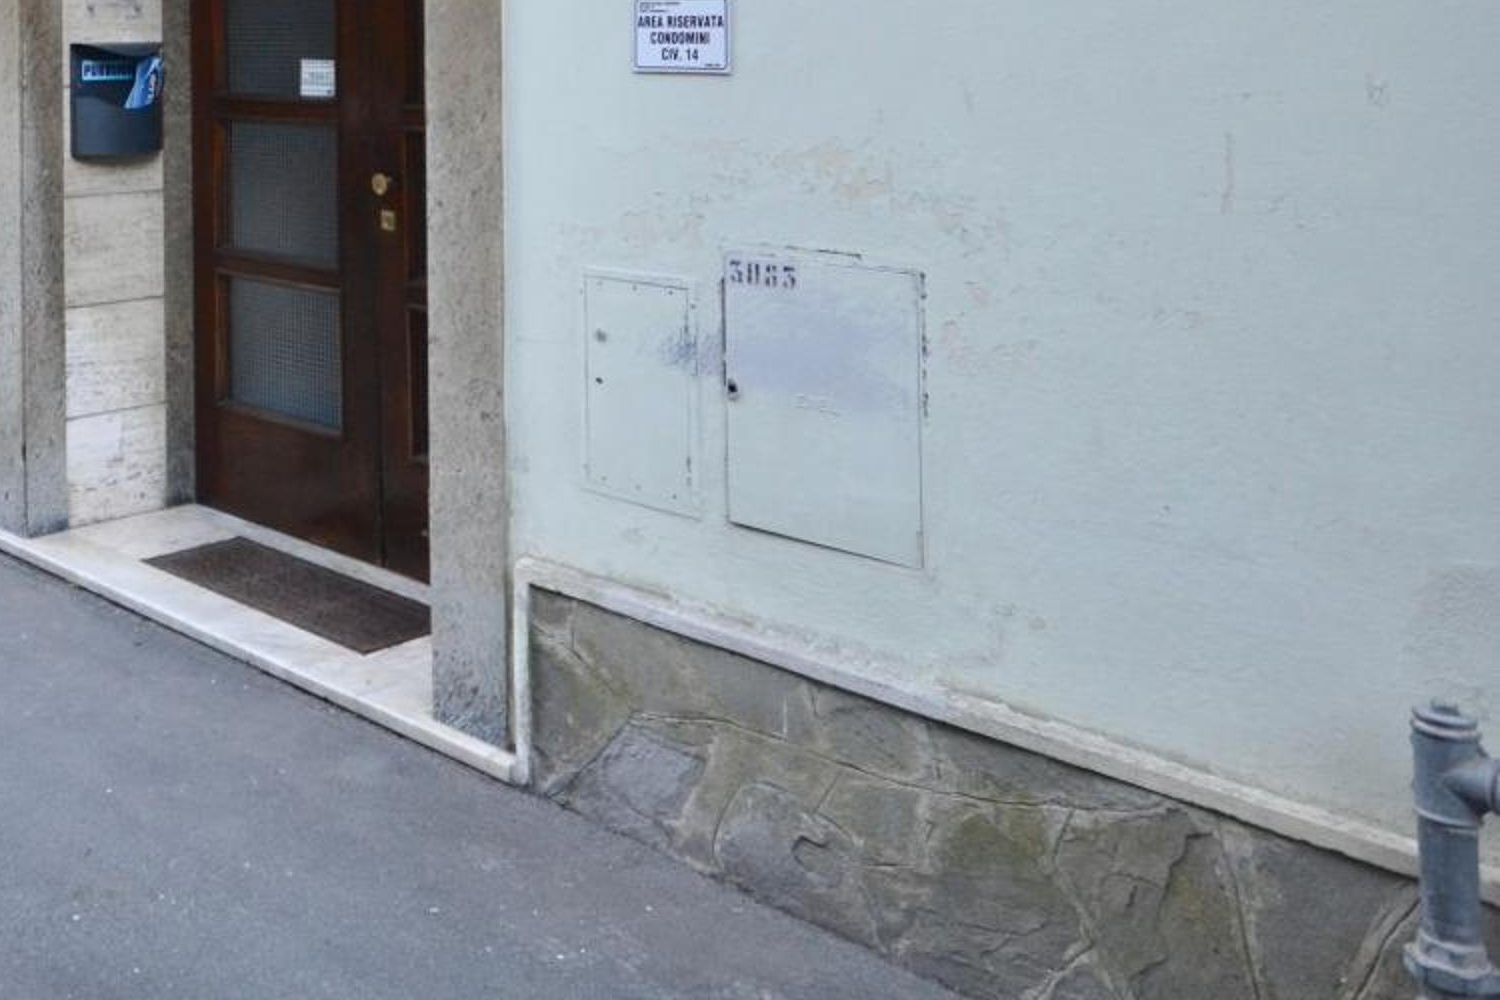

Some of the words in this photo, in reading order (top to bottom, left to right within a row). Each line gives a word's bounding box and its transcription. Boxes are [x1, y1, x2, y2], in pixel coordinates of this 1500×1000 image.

[638, 15, 663, 28] AREA
[667, 15, 724, 29] RISERVATA
[650, 31, 710, 45] CONDOMINI
[685, 48, 699, 61] 14
